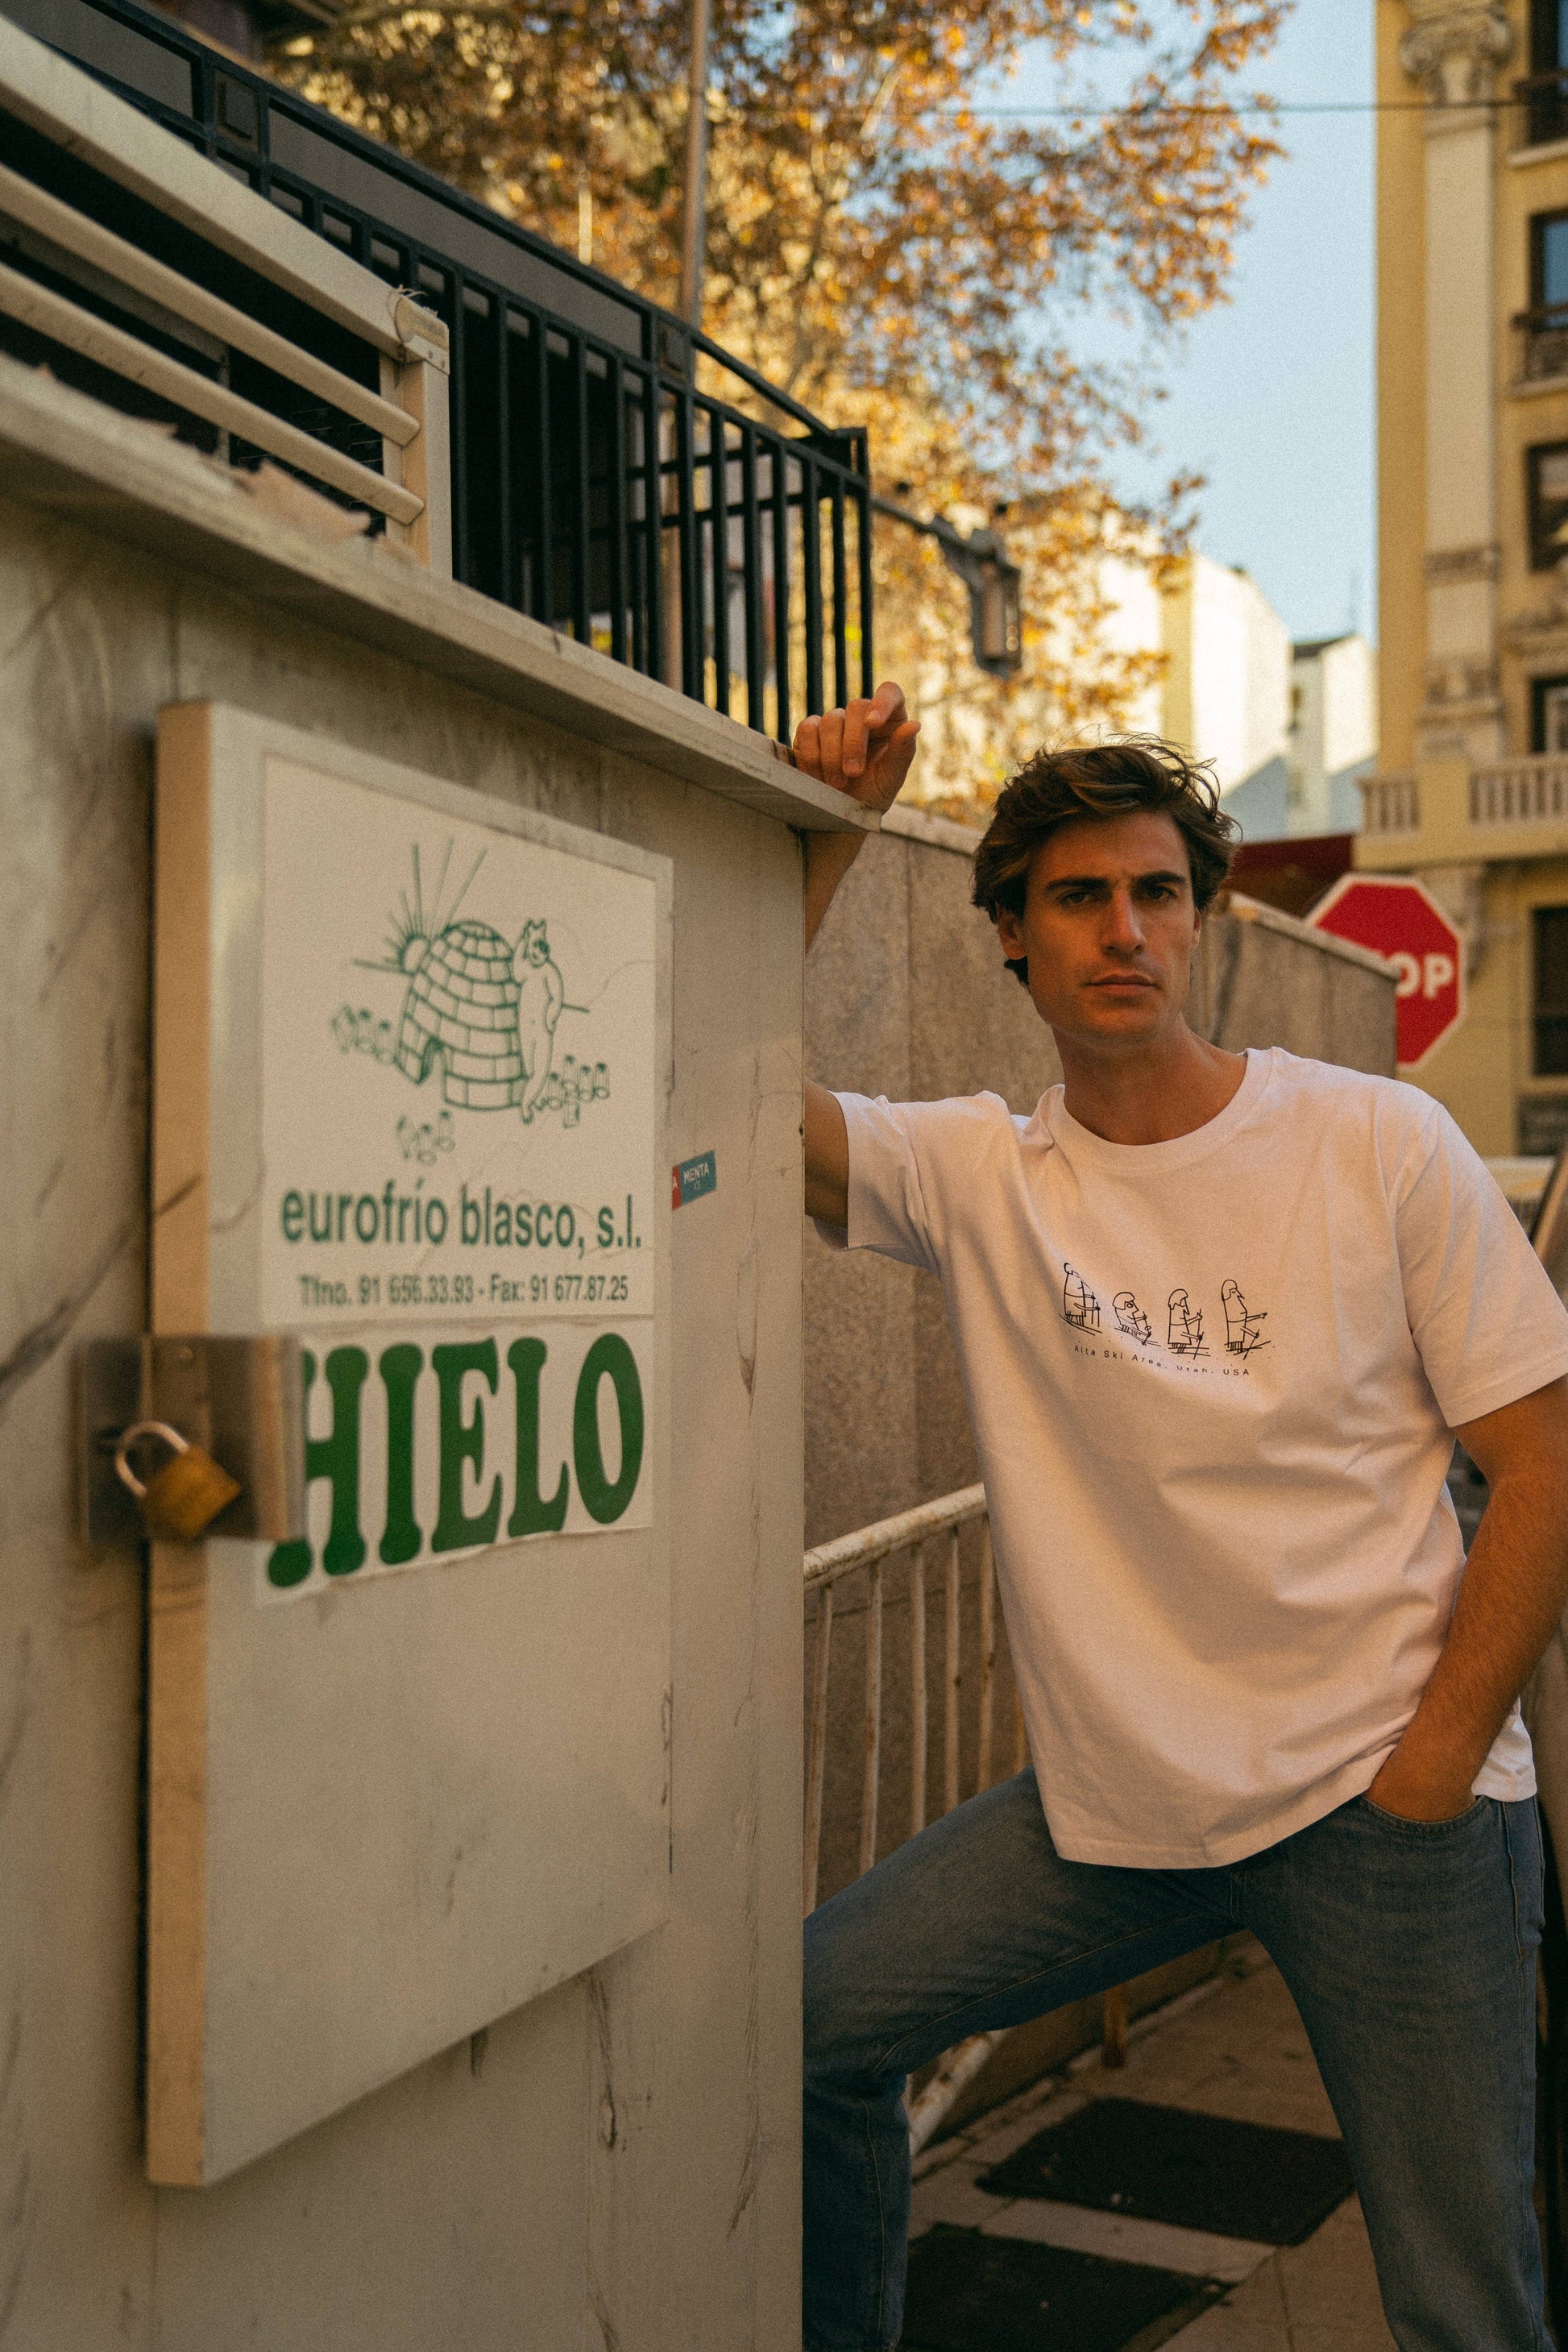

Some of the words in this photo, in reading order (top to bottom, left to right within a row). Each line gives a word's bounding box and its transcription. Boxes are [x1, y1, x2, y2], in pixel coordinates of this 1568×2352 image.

[1383, 952, 1454, 1000] OP
[683, 1162, 710, 1185] MENTA
[281, 1179, 448, 1246] eurofrío
[460, 1185, 586, 1259] blasco,
[597, 1193, 642, 1249] s.l.
[360, 1275, 380, 1305] 91
[489, 1272, 525, 1302] Fax:
[530, 1274, 548, 1302] 91
[555, 1274, 628, 1302] 677.87.25
[1074, 1345, 1096, 1356] Alta
[1104, 1350, 1123, 1359] Ski
[1223, 1368, 1250, 1376] USA
[268, 1333, 644, 1587] HIELO
